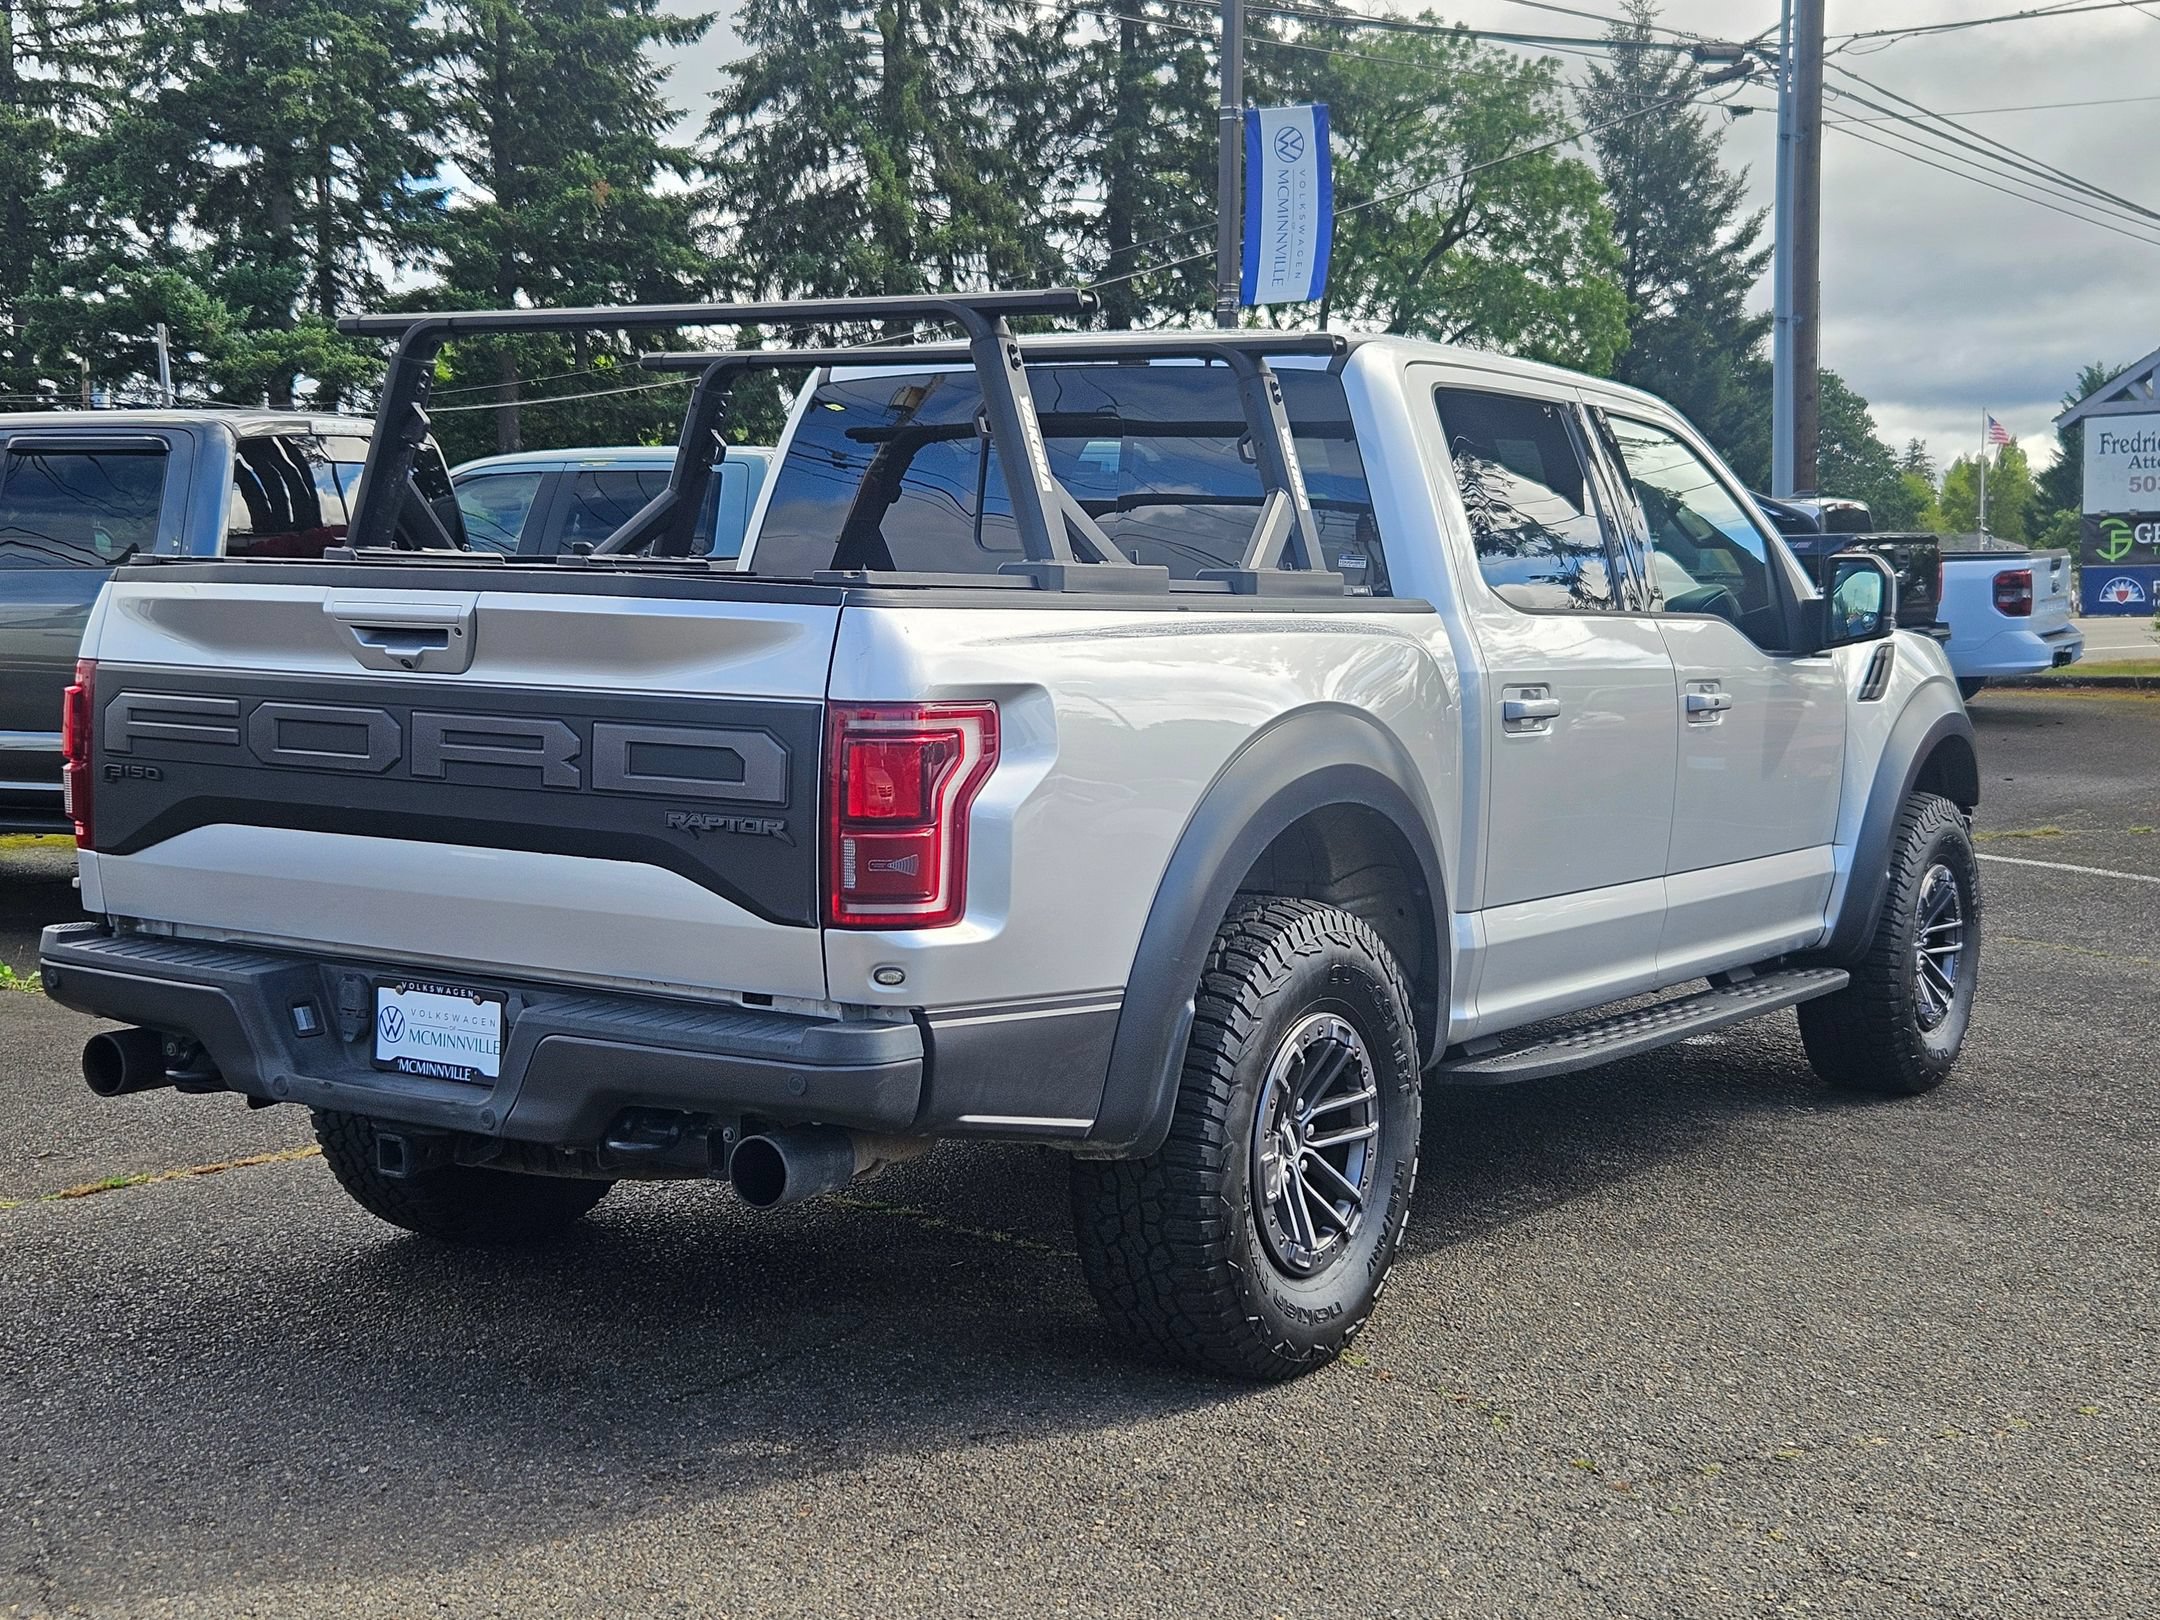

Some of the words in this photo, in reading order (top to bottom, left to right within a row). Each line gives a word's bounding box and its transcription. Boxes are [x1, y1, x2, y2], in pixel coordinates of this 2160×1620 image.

[1272, 168, 1290, 287] MCMINNVILLE
[1294, 168, 1306, 280] VOLKSWAGEN
[1019, 395, 1053, 492] YAKIMA
[2129, 476, 2160, 493] 50
[103, 689, 788, 804] FORD
[664, 808, 797, 848] RAPTOR
[402, 981, 474, 998] VOLKSWAGEN
[410, 1008, 497, 1028] VOLKSWAGEN
[408, 1028, 500, 1056] MCMINNVILLE
[397, 1058, 471, 1081] MCMINNVILLE
